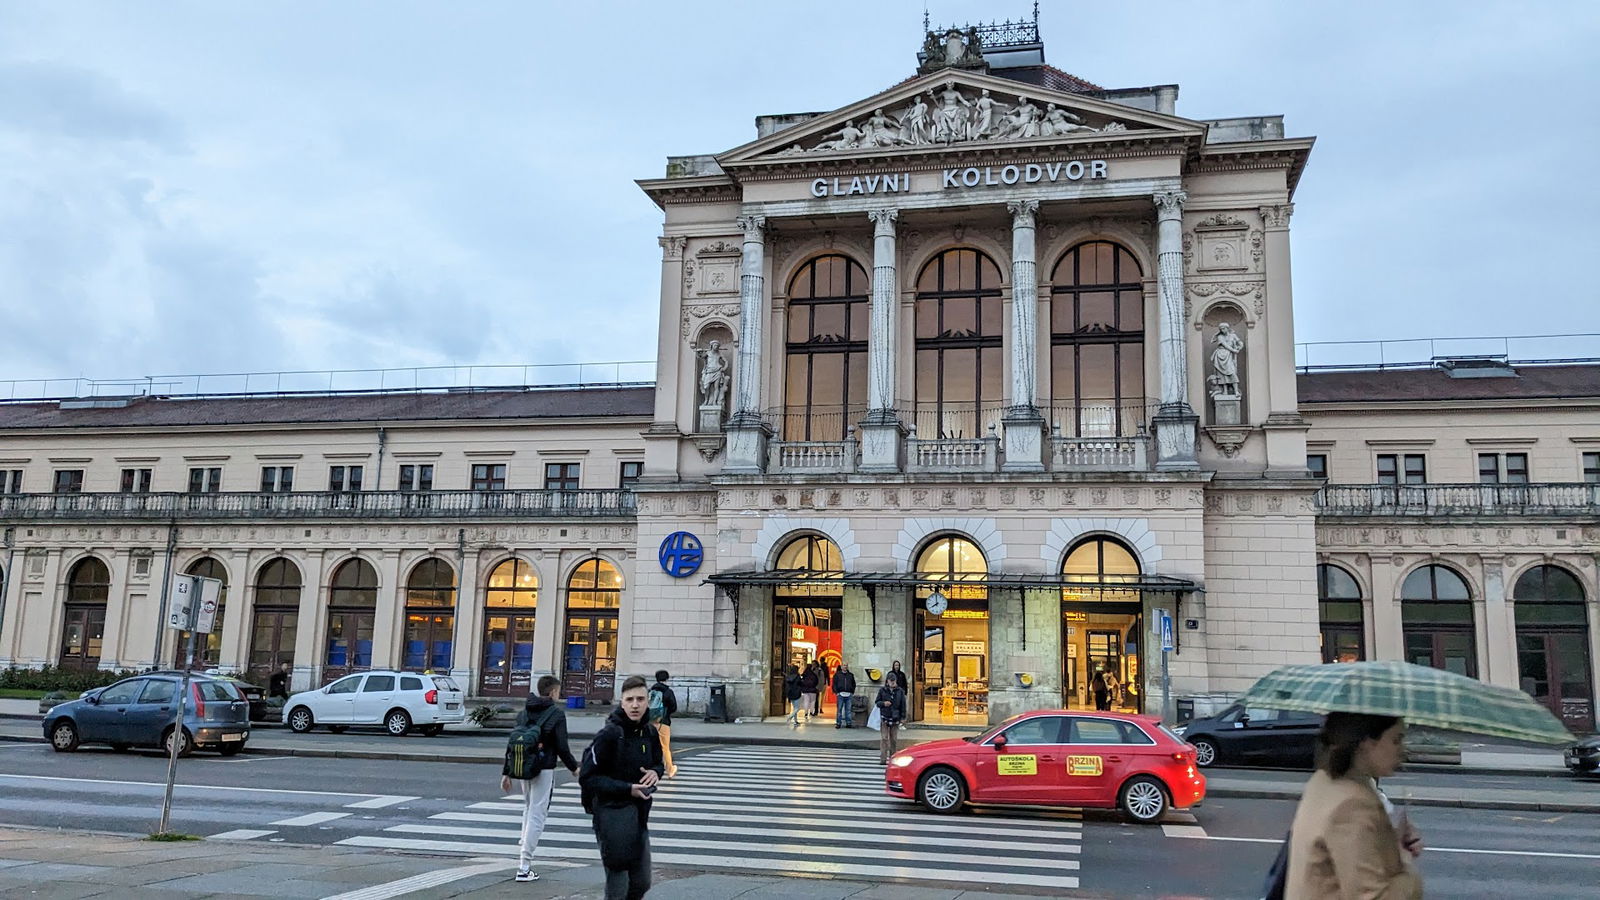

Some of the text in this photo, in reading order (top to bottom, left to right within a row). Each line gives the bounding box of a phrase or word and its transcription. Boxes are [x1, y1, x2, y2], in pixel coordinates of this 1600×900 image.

[811, 160, 1108, 197] GLAVNI KOLODVOR
[1068, 757, 1102, 774] BRZINA
